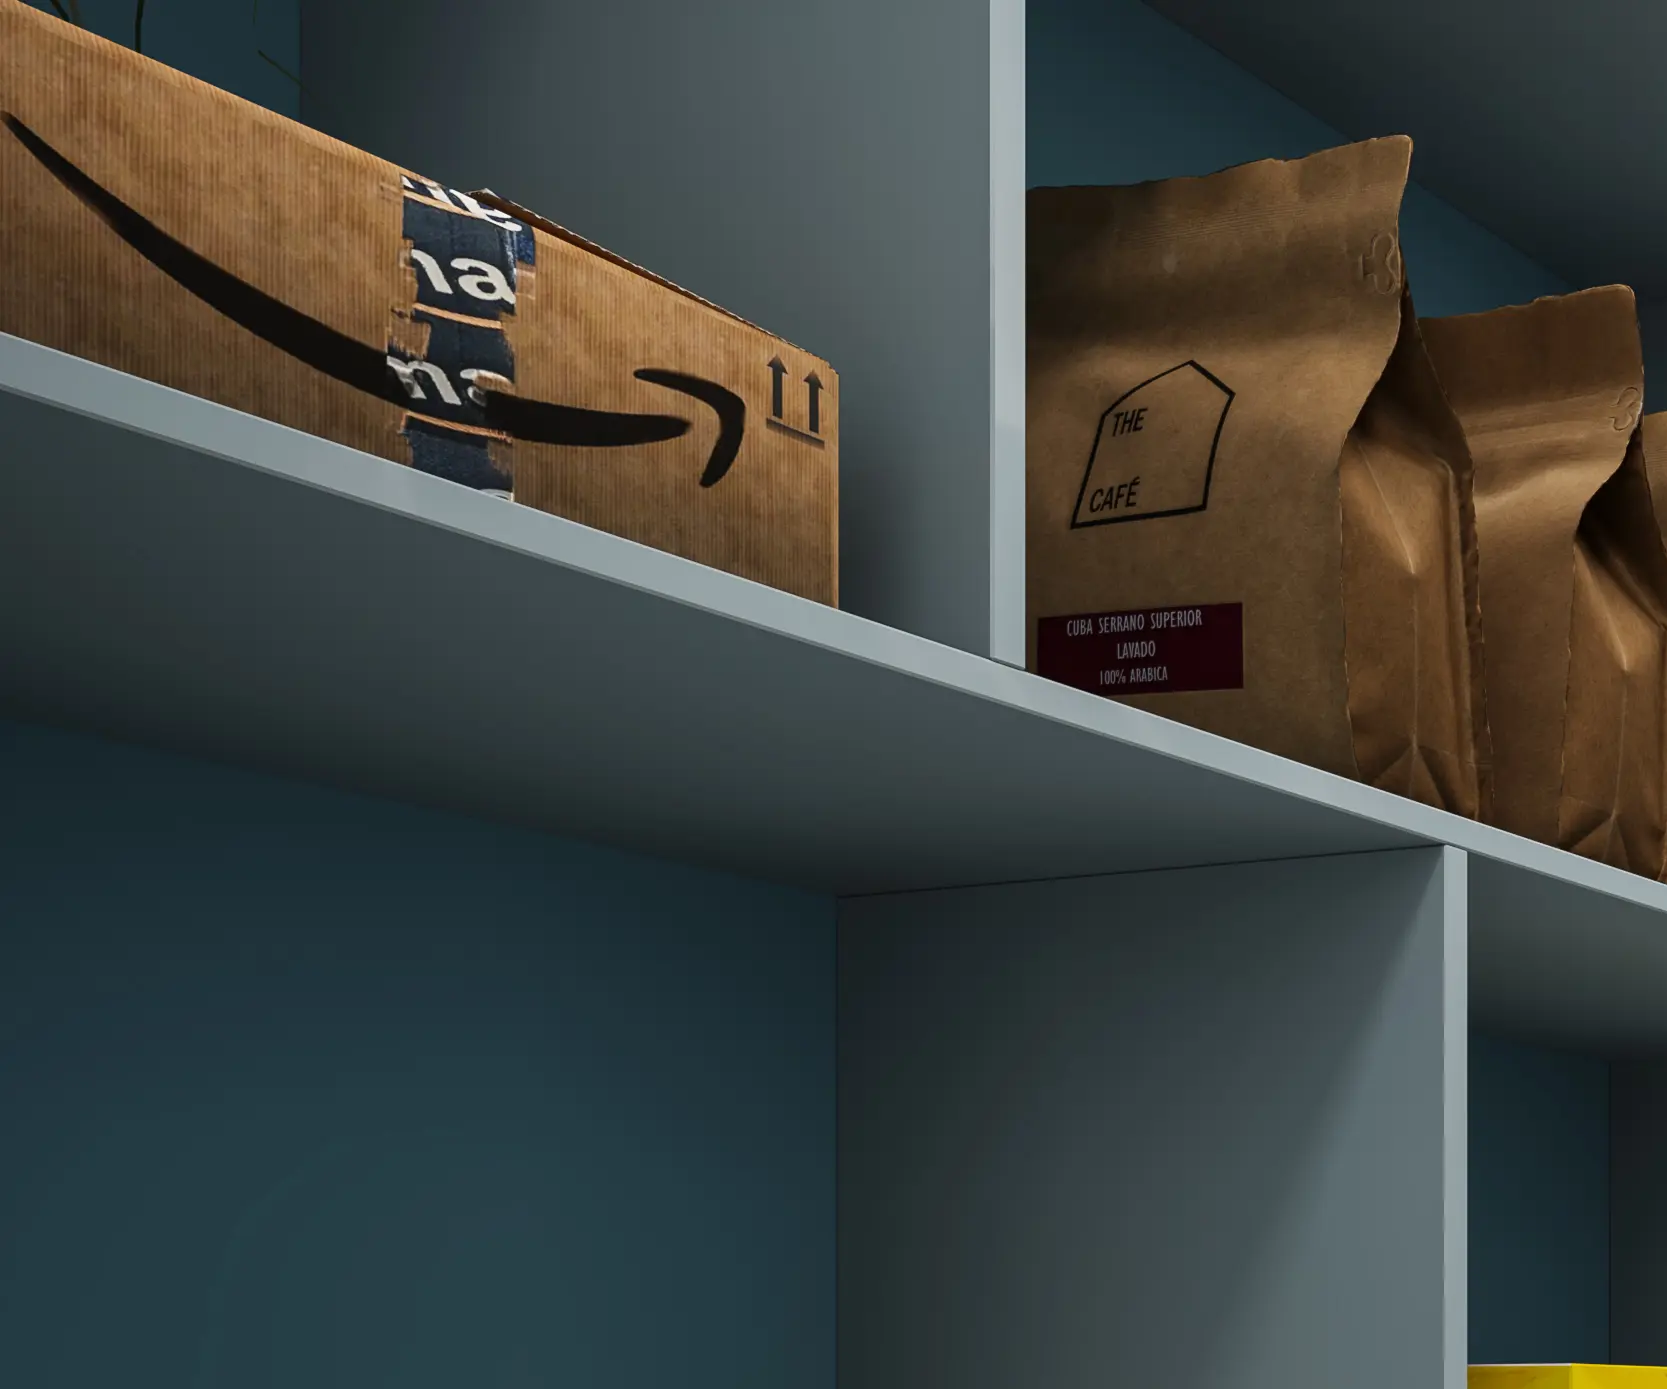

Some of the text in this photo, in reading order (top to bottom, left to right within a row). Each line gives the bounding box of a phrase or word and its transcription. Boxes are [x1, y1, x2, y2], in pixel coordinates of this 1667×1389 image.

[1111, 406, 1148, 437] THE
[1088, 476, 1141, 513] CAFÉ
[1066, 608, 1203, 637] CUBA SERRANO SUPERIOR
[1116, 640, 1156, 660] LAVADO
[1100, 666, 1168, 686] 100% ARABICA
